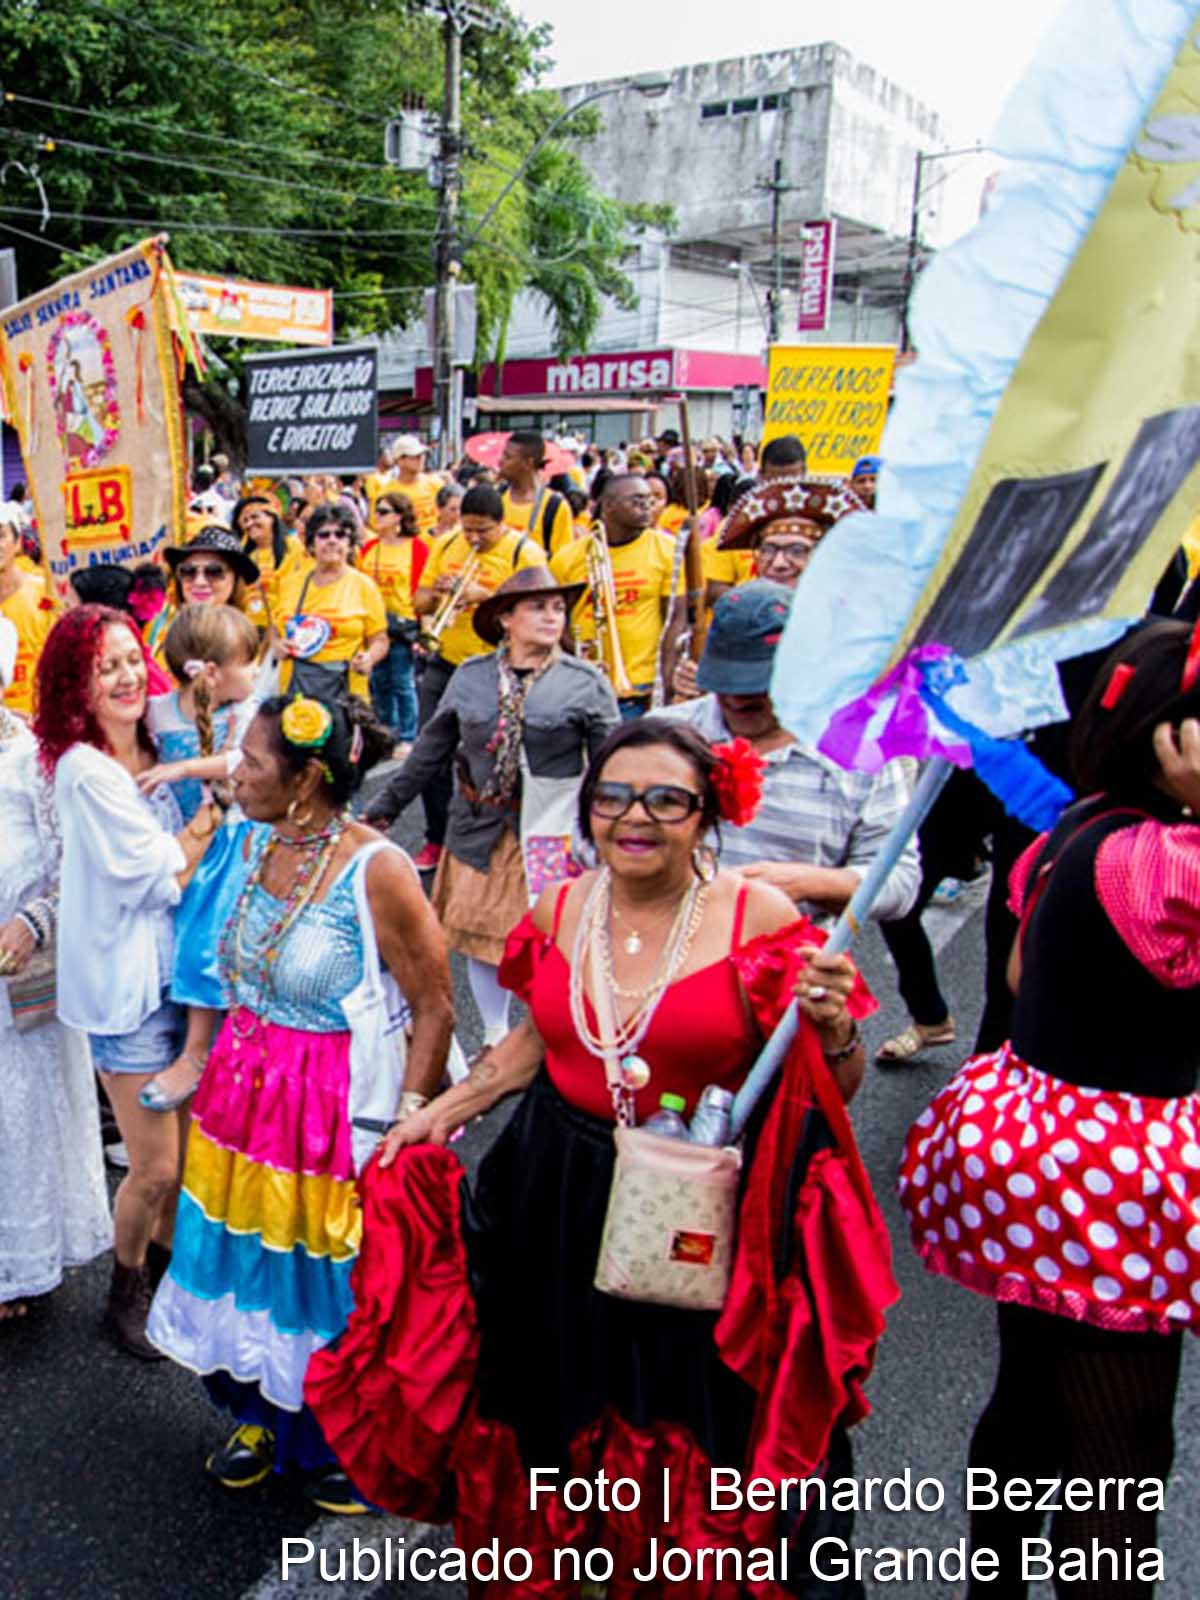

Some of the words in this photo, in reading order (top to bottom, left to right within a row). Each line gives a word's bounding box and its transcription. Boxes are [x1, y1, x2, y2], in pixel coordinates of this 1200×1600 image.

[801, 226, 825, 314] marisa
[546, 358, 670, 392] marisa
[773, 365, 887, 394] QUEREMOS
[267, 427, 282, 452] E
[281, 422, 358, 452] DIREITOS
